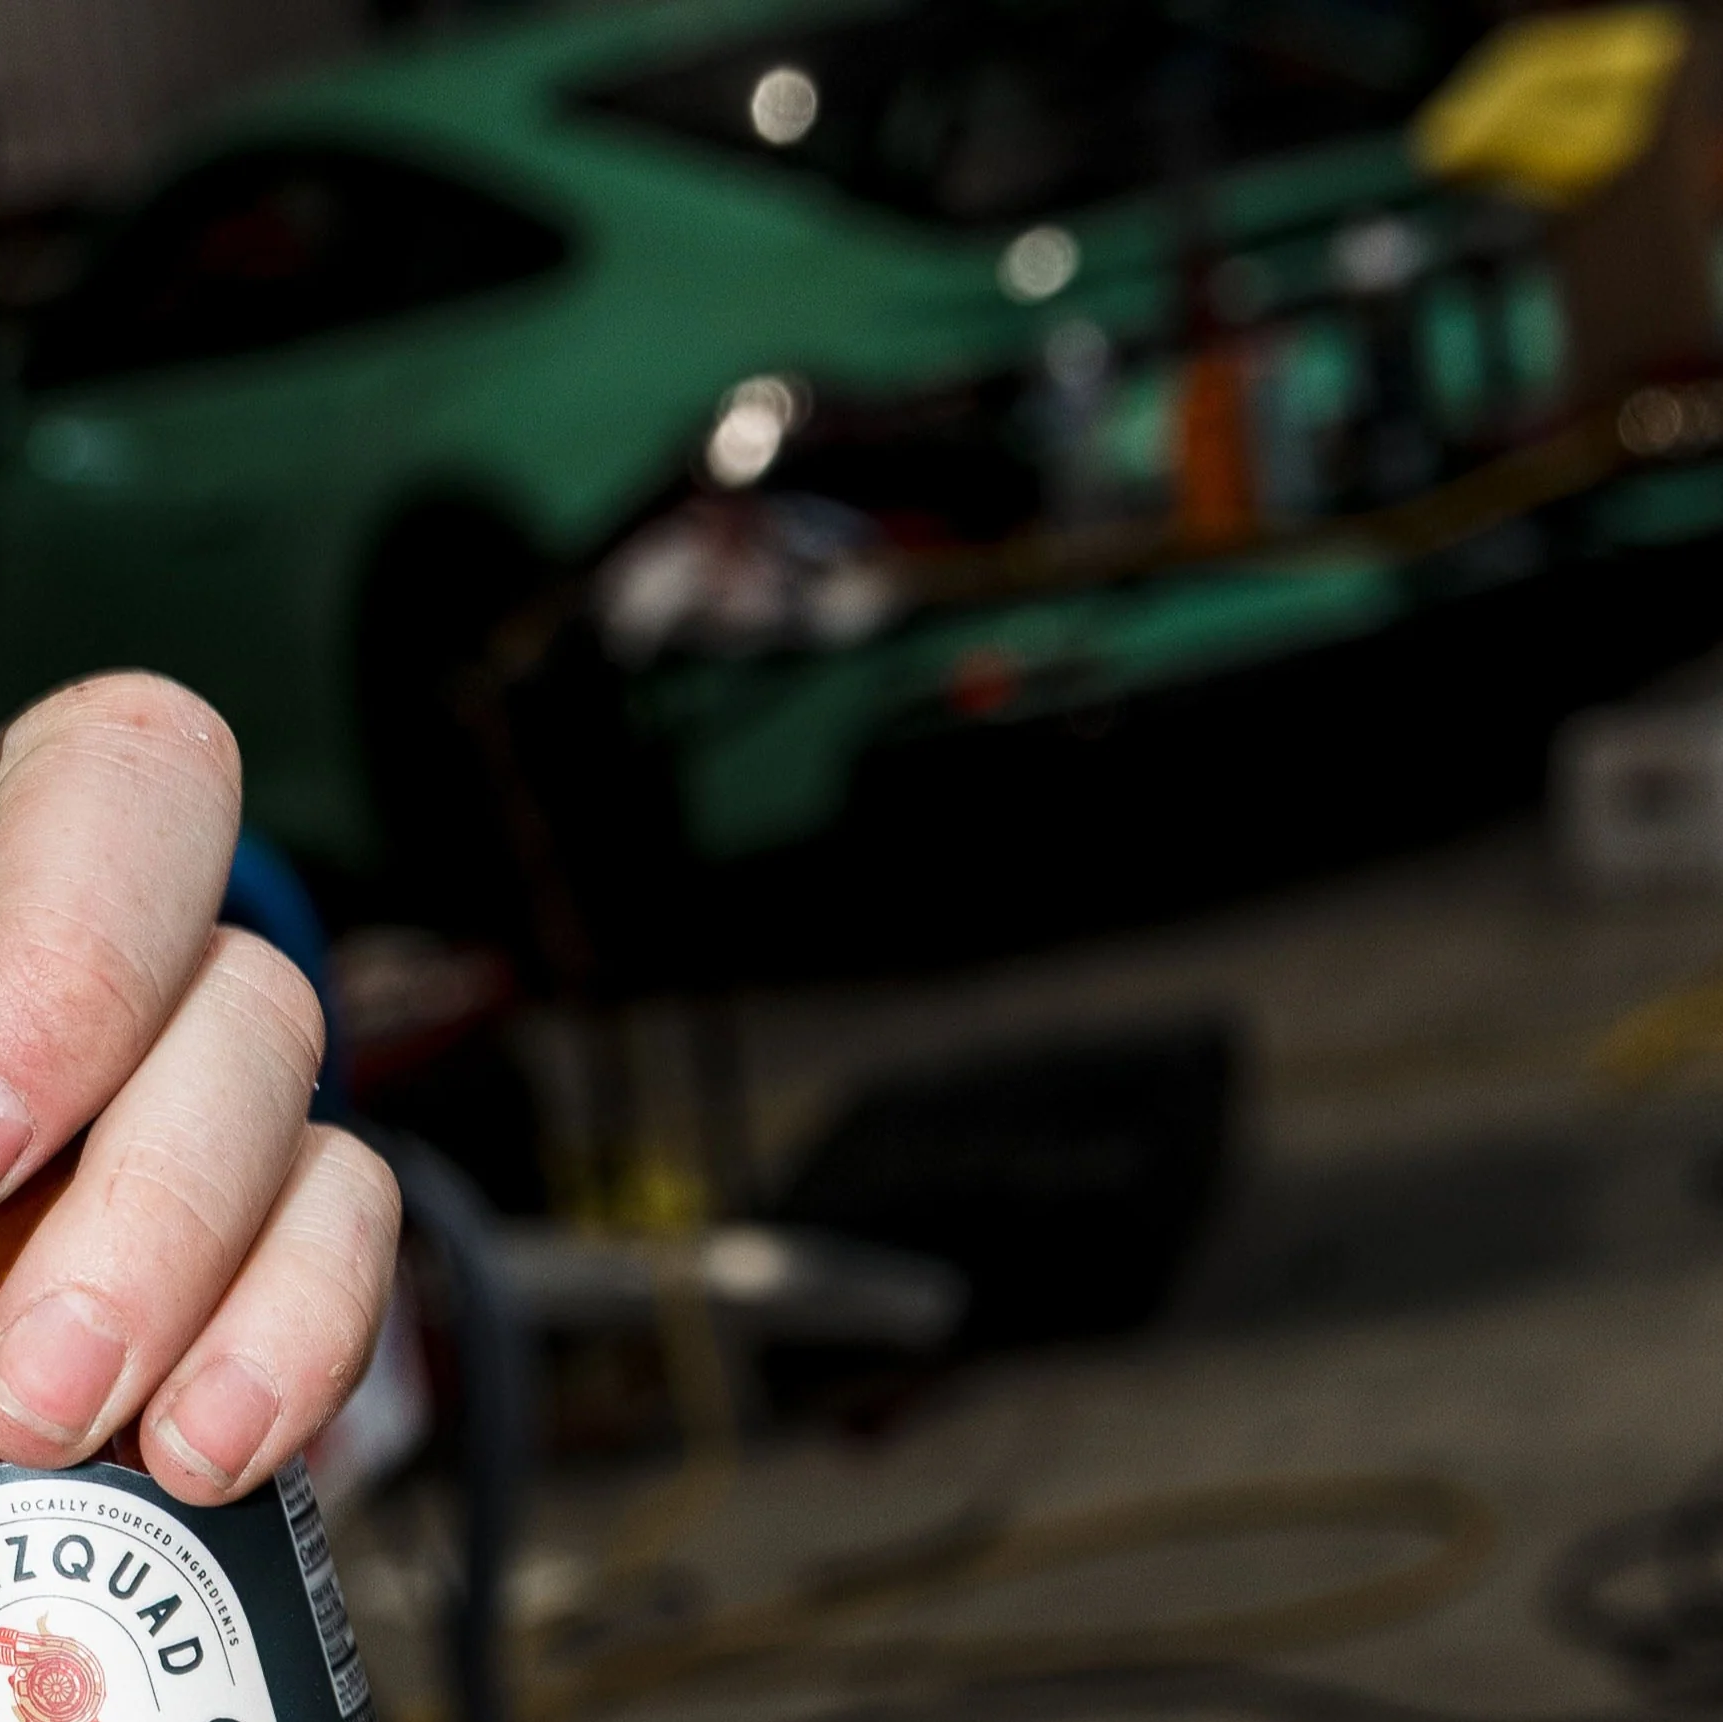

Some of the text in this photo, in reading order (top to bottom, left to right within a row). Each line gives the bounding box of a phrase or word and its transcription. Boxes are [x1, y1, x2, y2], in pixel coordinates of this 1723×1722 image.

[11, 1498, 88, 1514] LOCALLY
[96, 1503, 173, 1547] SOURCED
[175, 1545, 240, 1647] INGREDIENTS
